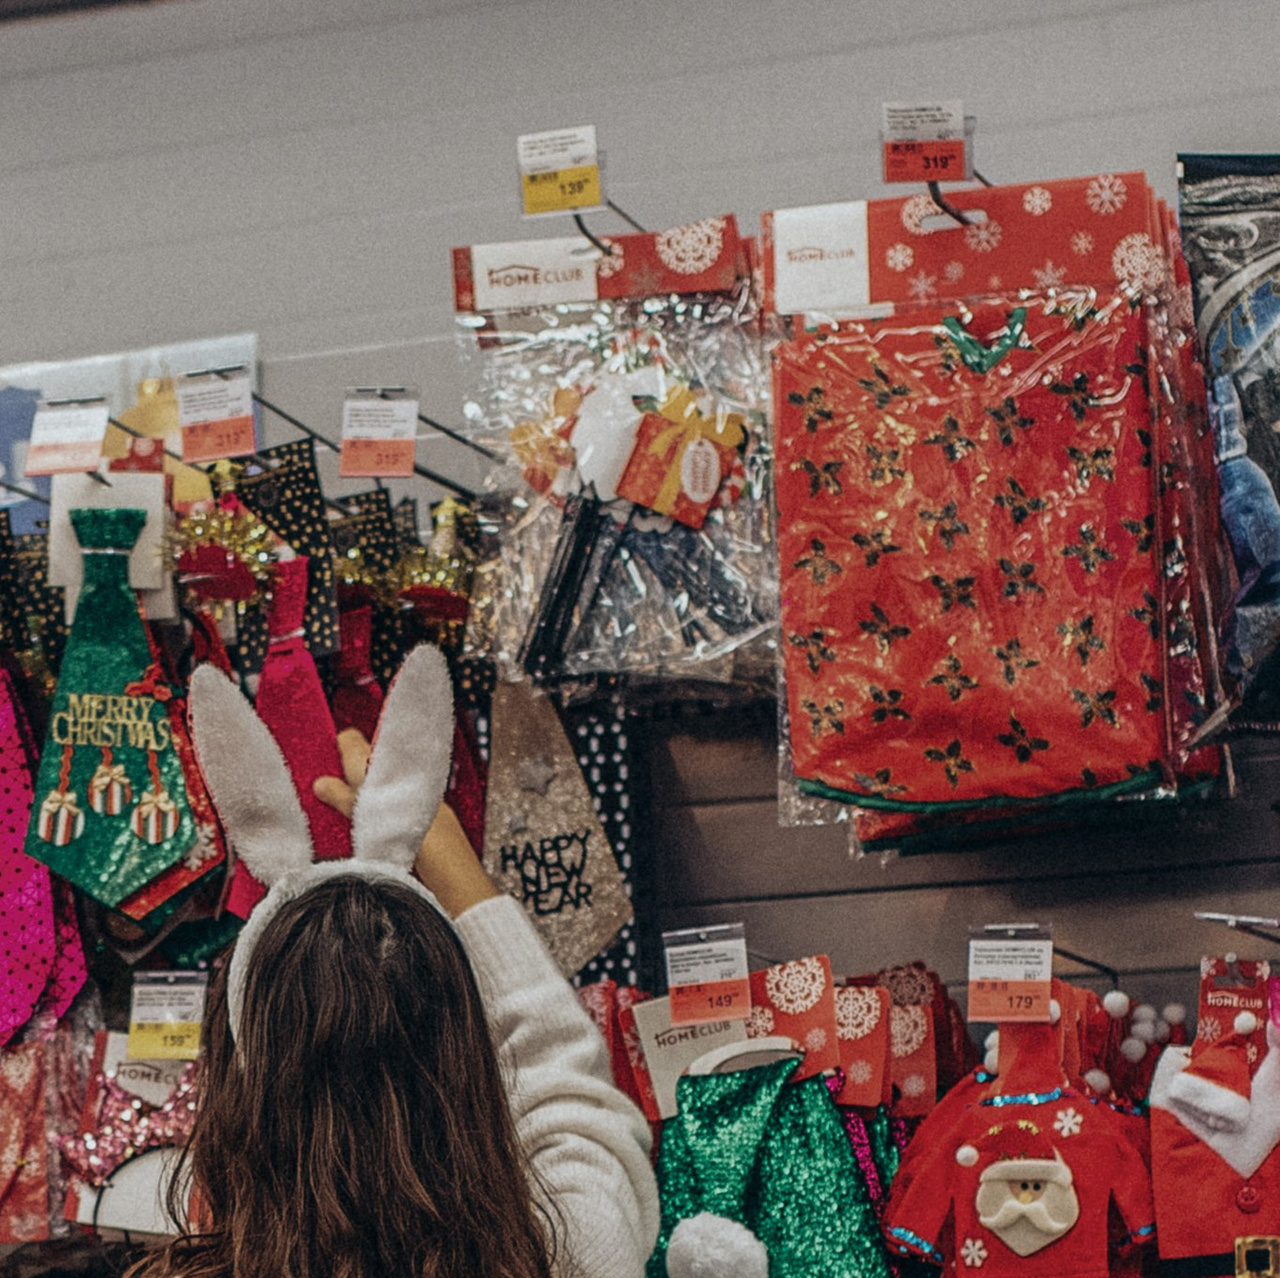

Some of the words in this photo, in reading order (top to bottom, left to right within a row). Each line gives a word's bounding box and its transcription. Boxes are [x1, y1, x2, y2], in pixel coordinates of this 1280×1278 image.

[923, 155, 949, 170] 319
[787, 247, 855, 263] HOMECLUB
[488, 265, 584, 288] HOMECLUB
[68, 693, 155, 721] MERRY
[52, 711, 171, 751] CHRISTMAS
[500, 829, 591, 873] HAPPY
[522, 861, 582, 893] NEW
[523, 882, 593, 915] YEAR
[708, 995, 733, 1009] 149
[1008, 996, 1033, 1009] 179
[1207, 991, 1263, 1009] HOMECLUB
[655, 1022, 731, 1048] HOMECLUB
